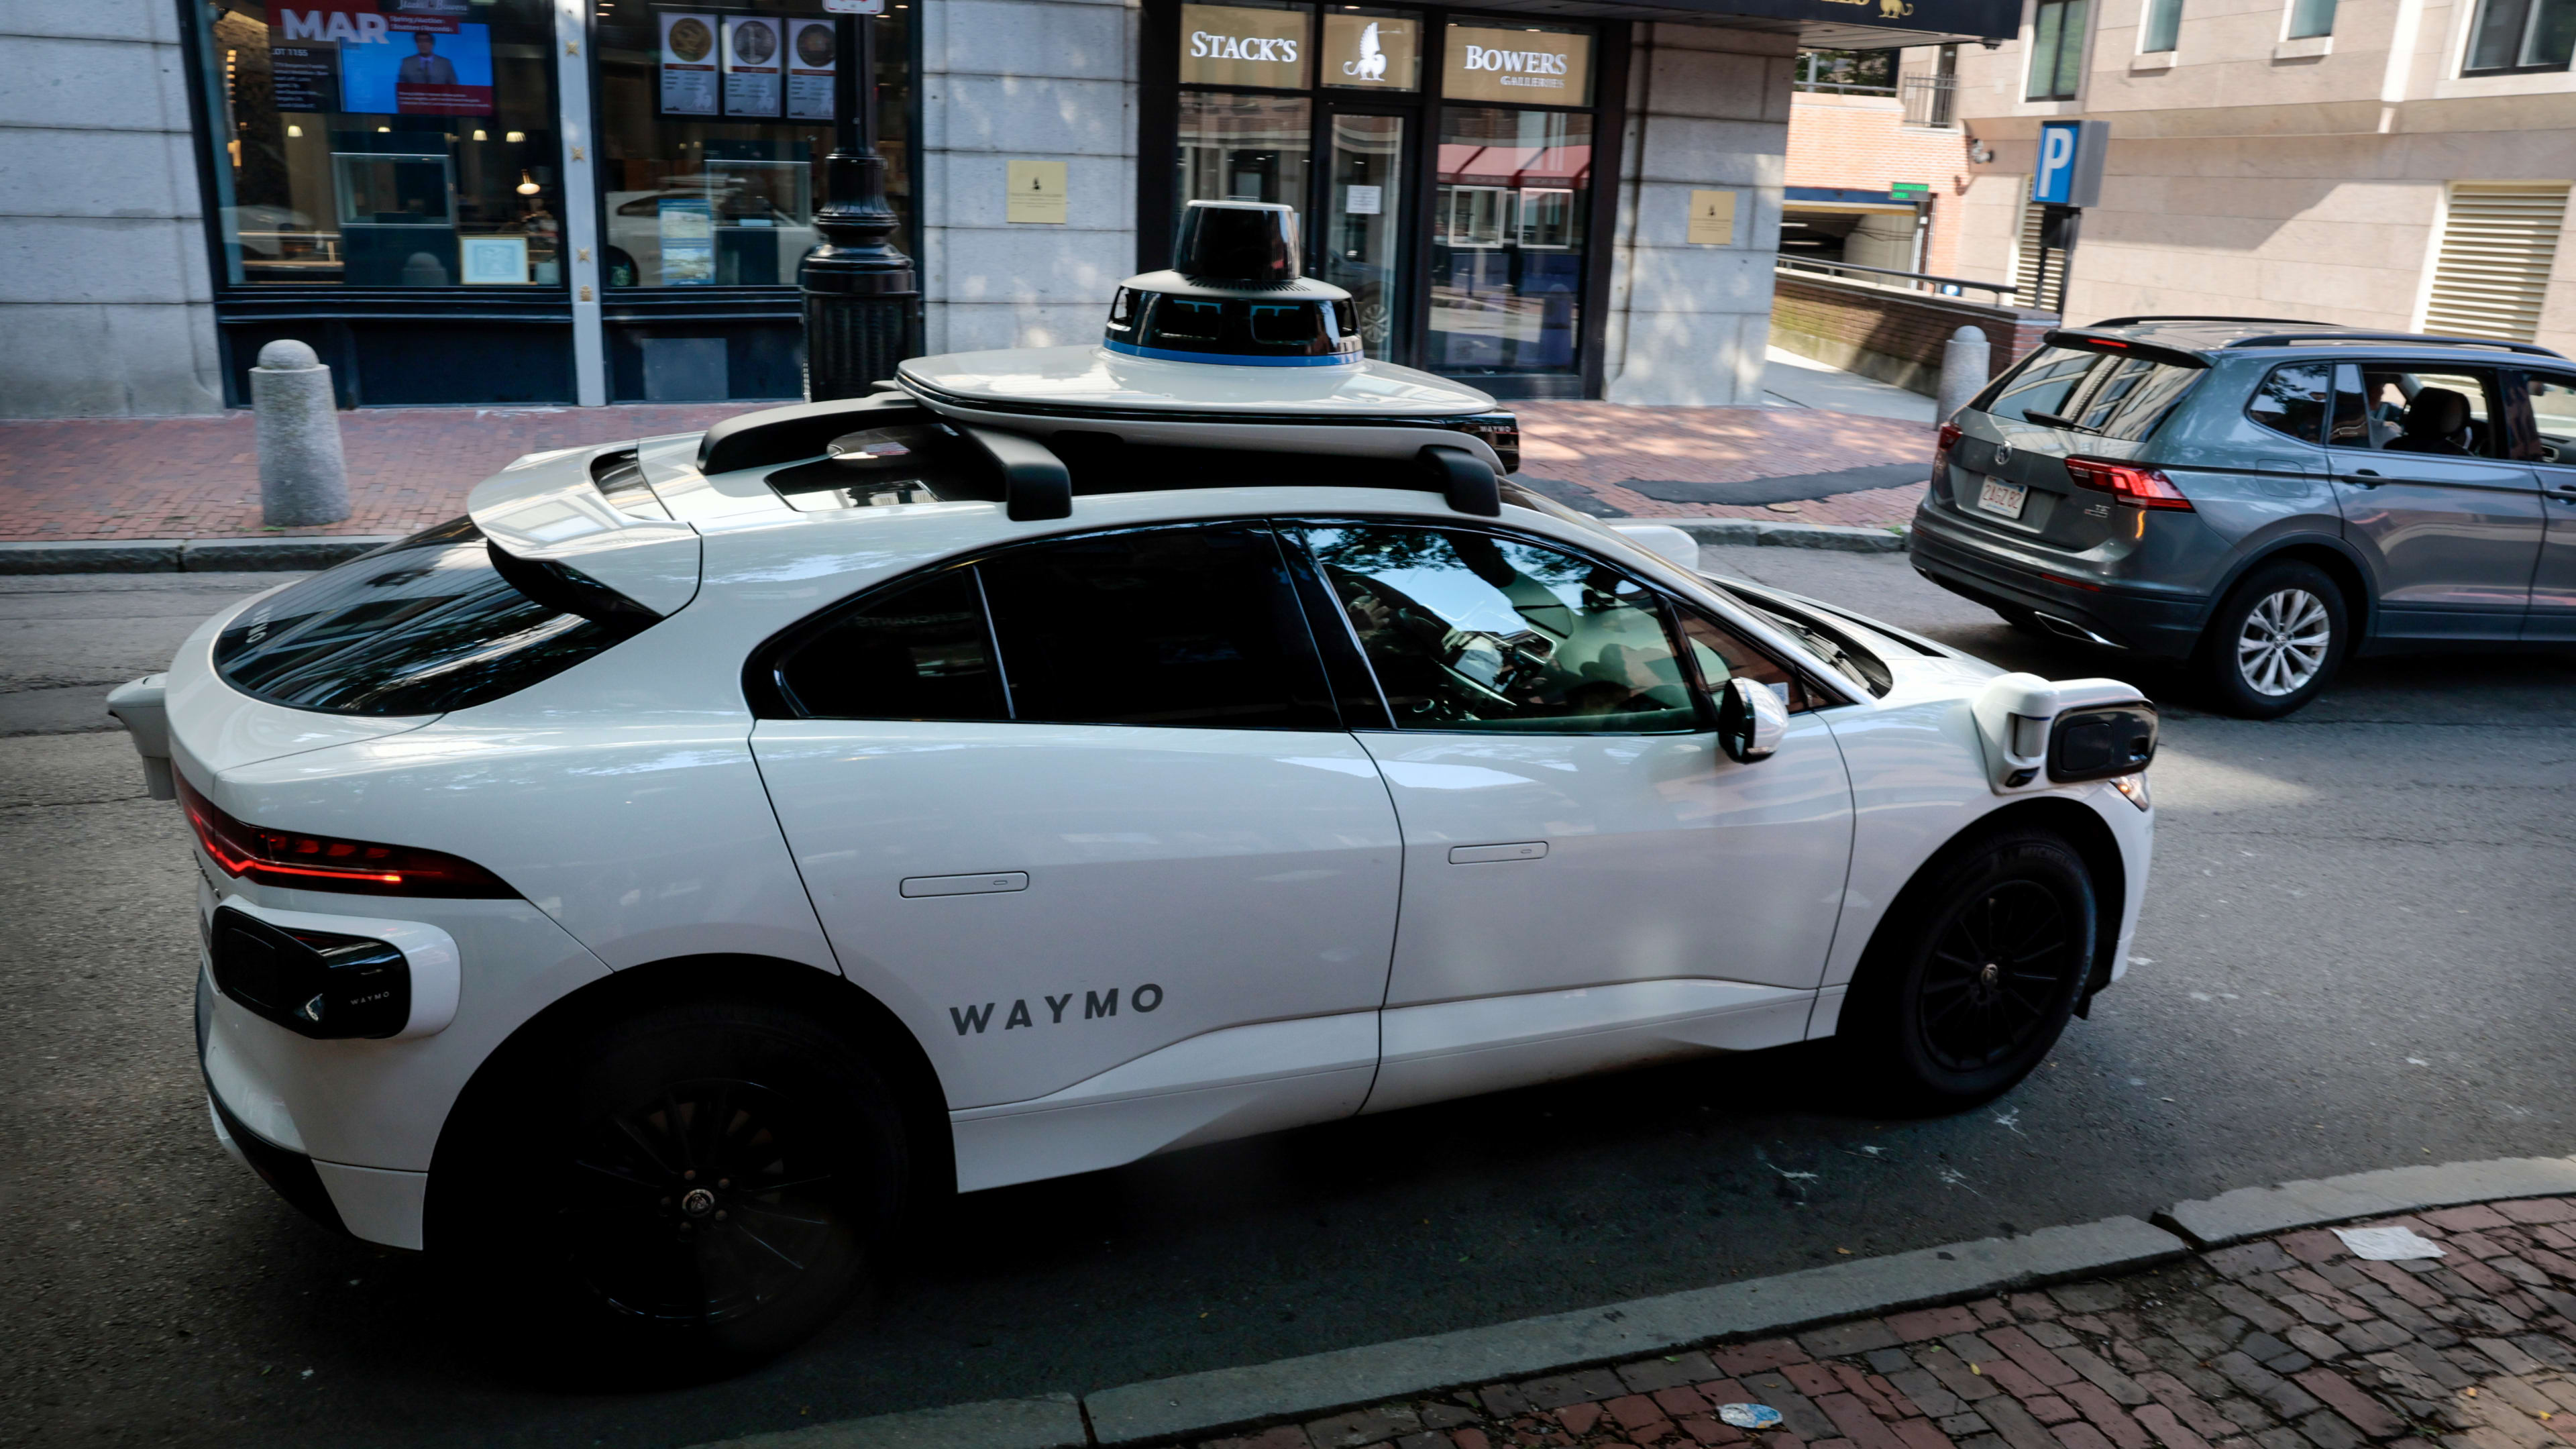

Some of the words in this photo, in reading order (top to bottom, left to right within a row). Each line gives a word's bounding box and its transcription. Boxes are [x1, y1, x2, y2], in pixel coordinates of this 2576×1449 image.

[280, 9, 390, 44] MAR
[1190, 31, 1297, 62] STACK'S
[1464, 45, 1568, 75] BOWERS
[1500, 76, 1565, 89] GALLERIES
[2037, 127, 2074, 197] P
[350, 991, 390, 1006] WAYMO
[949, 983, 1163, 1036] WAYMO
